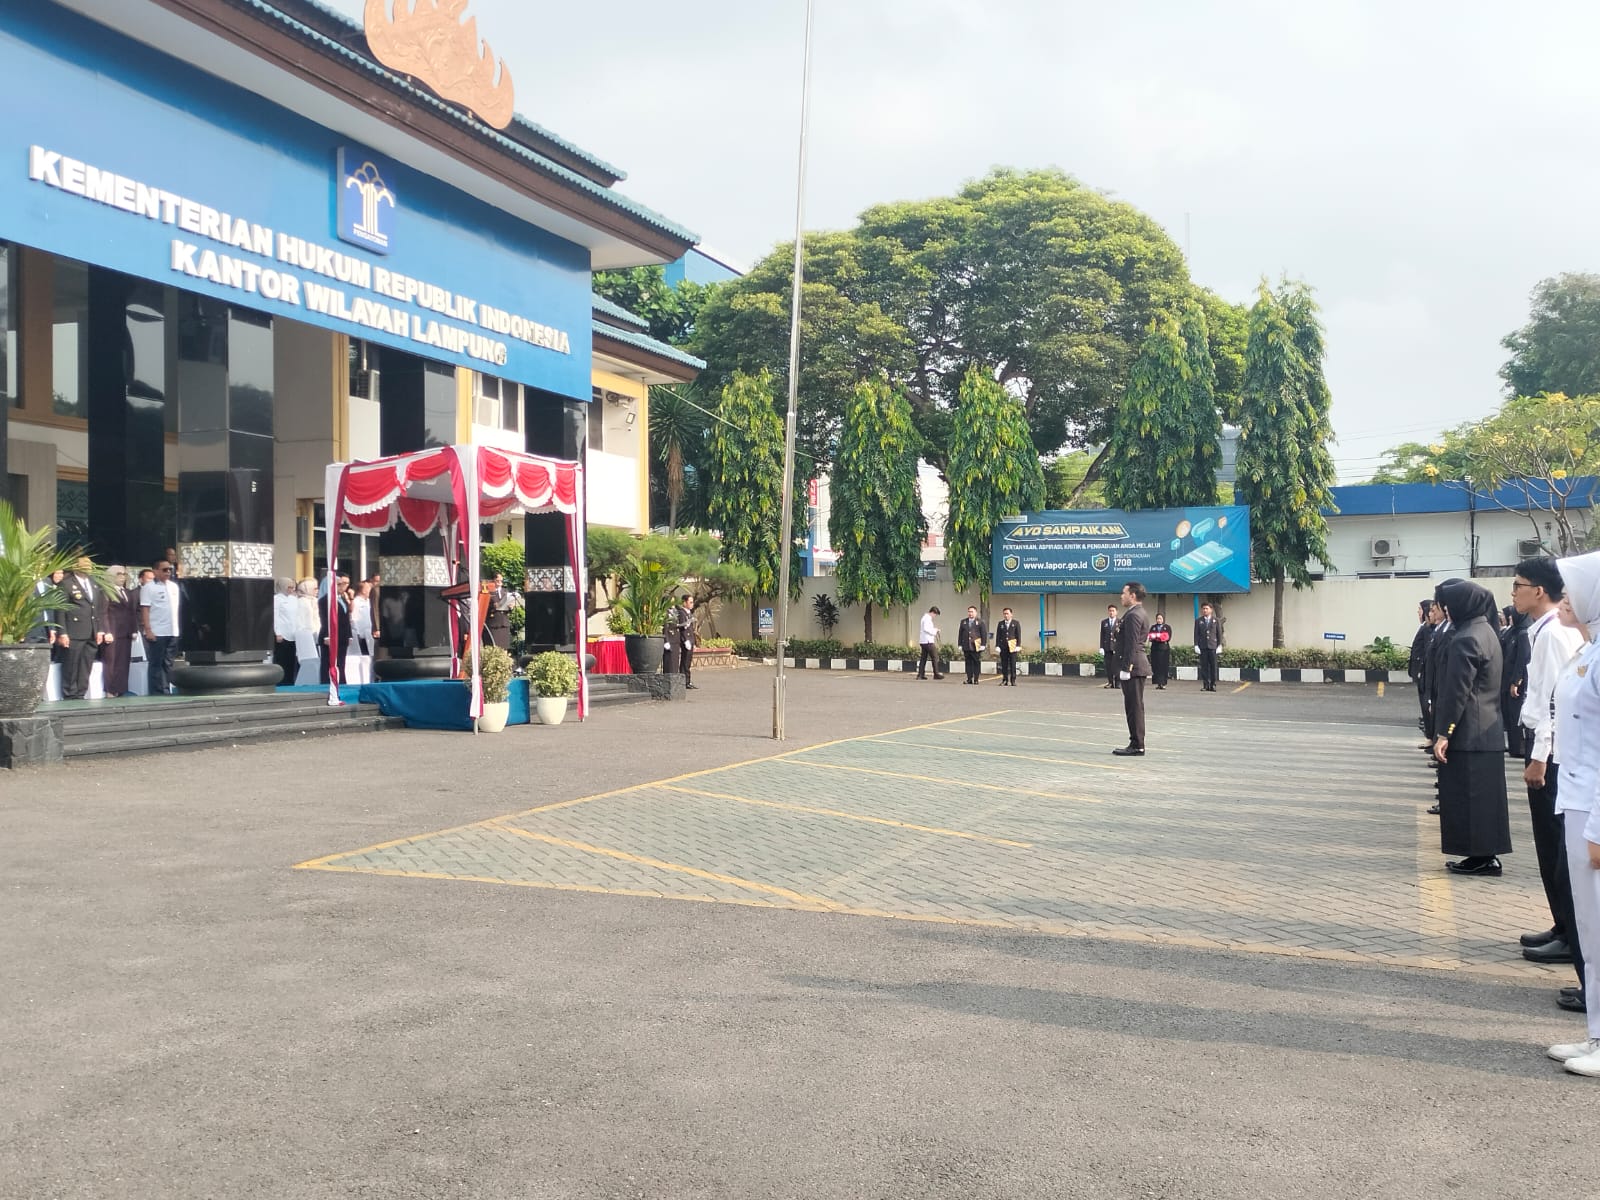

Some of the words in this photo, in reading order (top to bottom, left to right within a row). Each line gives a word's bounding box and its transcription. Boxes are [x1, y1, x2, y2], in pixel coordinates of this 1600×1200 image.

[29, 144, 272, 257] KEMENTERIAN
[277, 232, 370, 288] HUKUM
[374, 266, 477, 324] REPUBLIK
[479, 304, 571, 355] INDONESIA
[170, 239, 300, 305] KANTOR
[303, 281, 409, 337] WILAYAH
[411, 315, 507, 365] LAMPUNG
[1012, 526, 1042, 537] AYO
[1023, 561, 1088, 571] www.lapor.go.id
[1113, 558, 1132, 567] 1708
